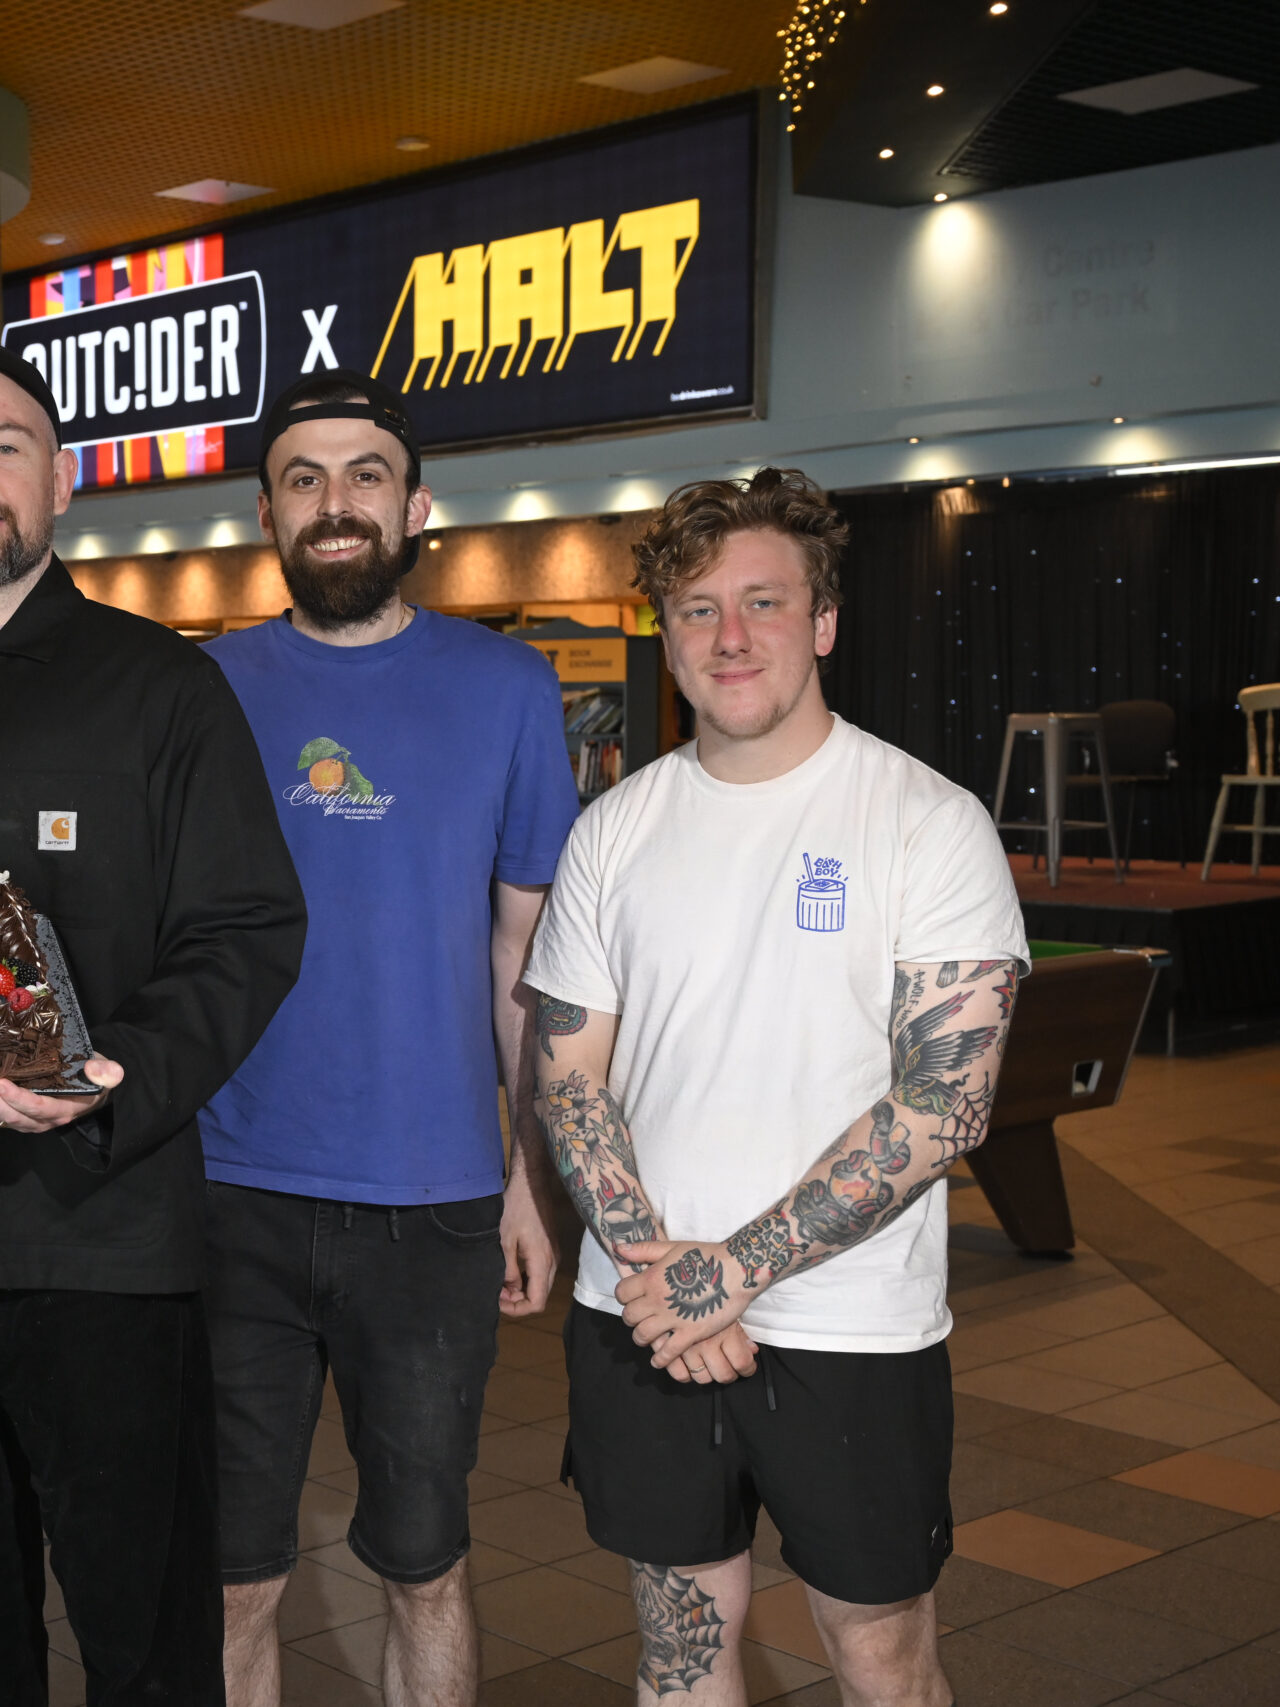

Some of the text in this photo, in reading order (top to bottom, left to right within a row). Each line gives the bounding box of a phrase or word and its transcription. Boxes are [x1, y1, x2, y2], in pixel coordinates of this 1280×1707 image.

[370, 199, 699, 393] HALT
[282, 782, 397, 806] California
[814, 867, 839, 878] BOY
